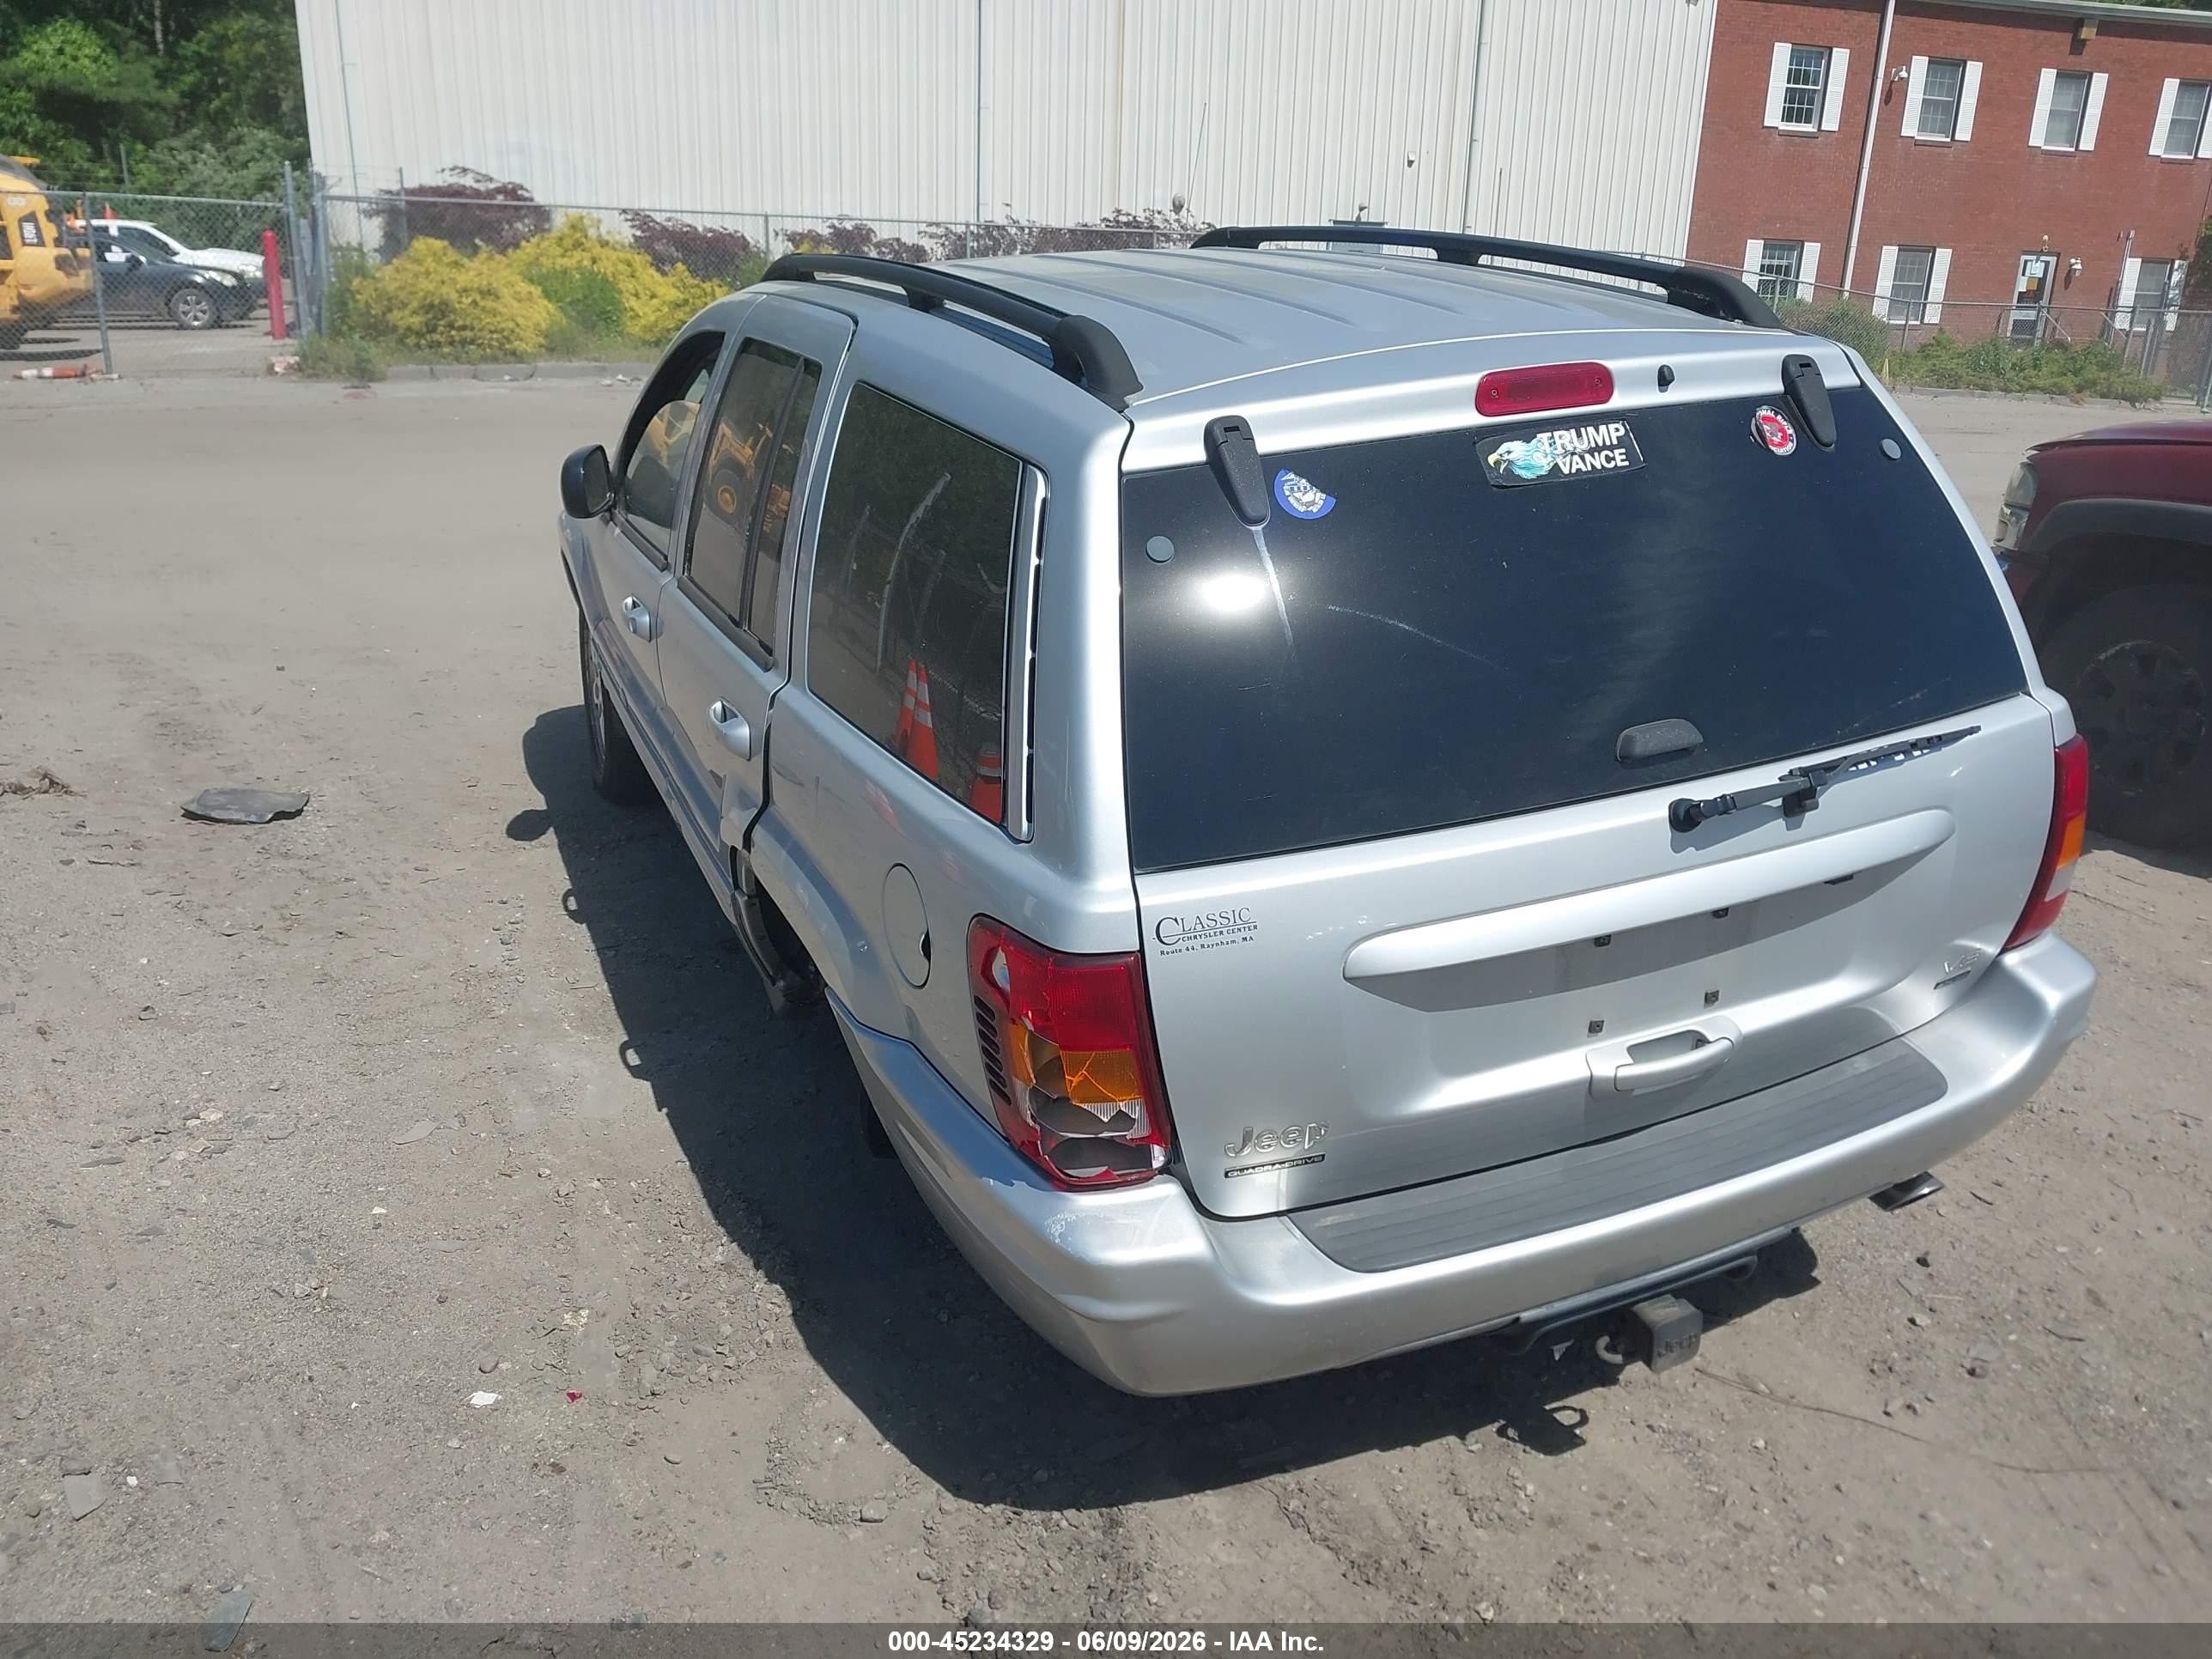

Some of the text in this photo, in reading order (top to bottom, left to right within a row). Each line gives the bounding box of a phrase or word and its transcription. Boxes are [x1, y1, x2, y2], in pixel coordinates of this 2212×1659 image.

[1536, 422, 1626, 454] TRUMP
[1555, 448, 1630, 474] VANCE
[1155, 907, 1251, 946] CLASSIC
[1182, 924, 1258, 942] CHRYSLER CENTER
[1159, 947, 1182, 957] Route
[1224, 1121, 1329, 1158] Jeep
